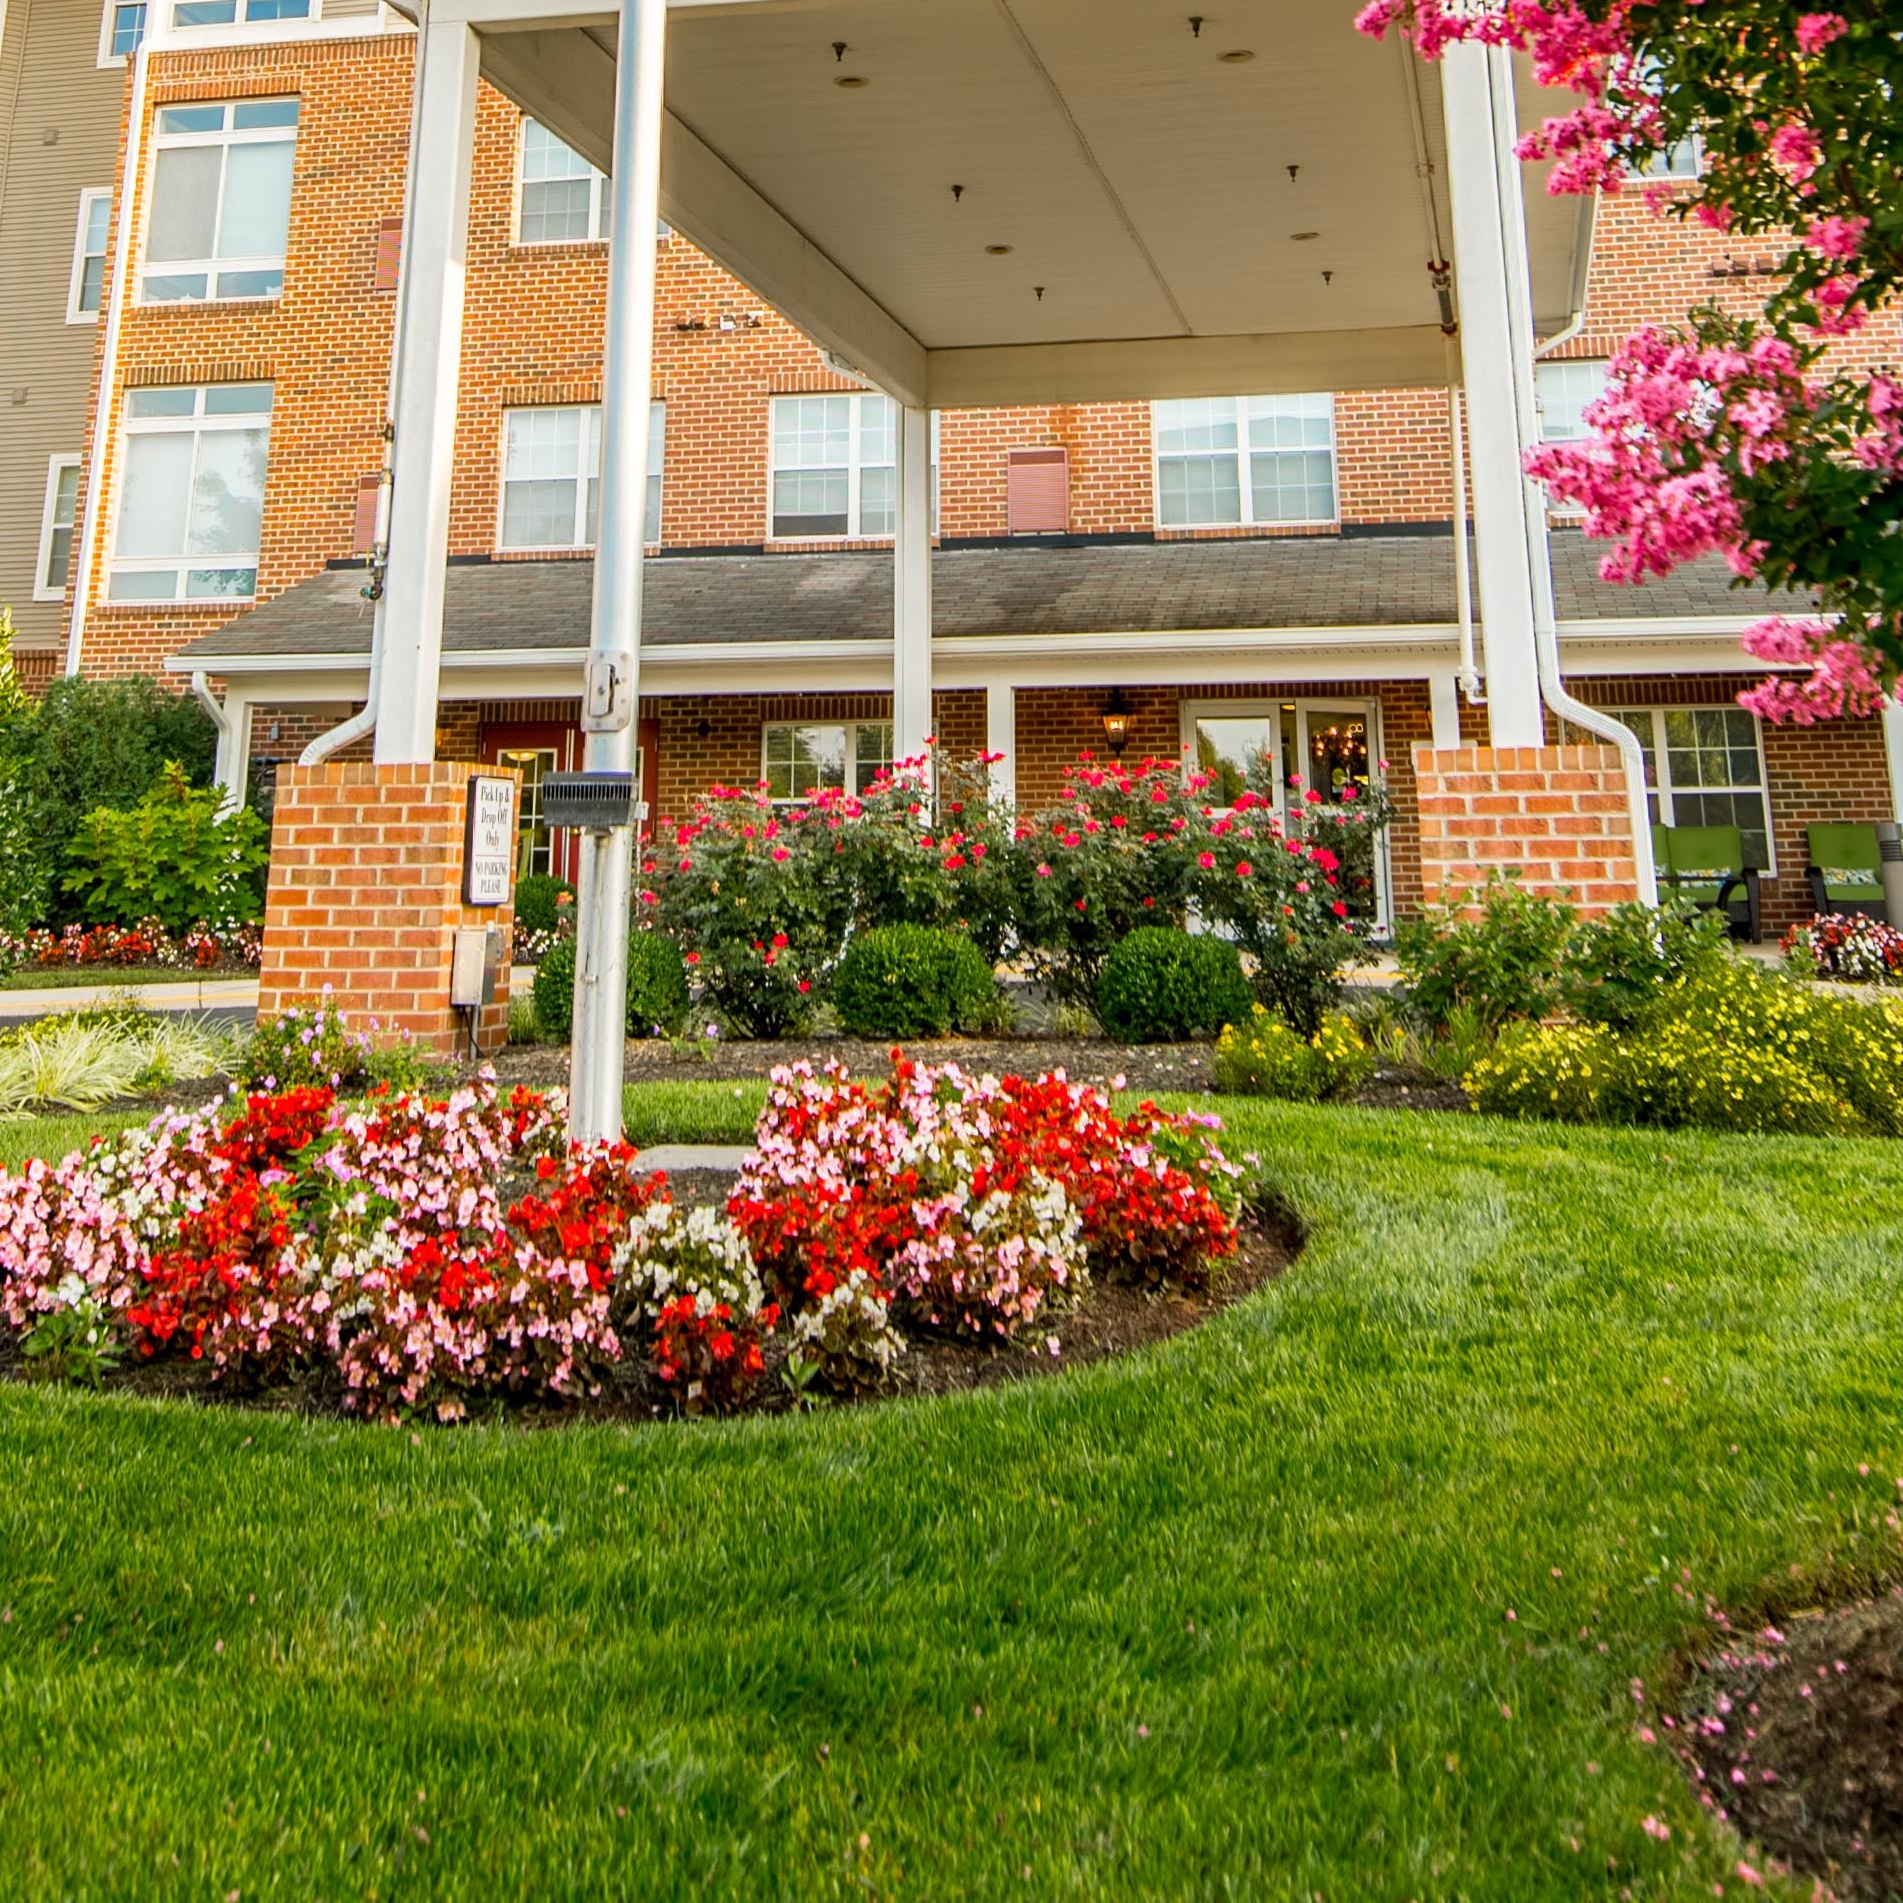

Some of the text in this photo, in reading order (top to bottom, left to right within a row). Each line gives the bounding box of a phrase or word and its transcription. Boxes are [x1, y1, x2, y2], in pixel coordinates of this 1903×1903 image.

[481, 785, 510, 806] Pick Up &
[481, 807, 508, 828] Drop Off
[485, 830, 500, 851] Only
[476, 861, 508, 876] NO PARKING
[480, 878, 501, 894] PLEASE
